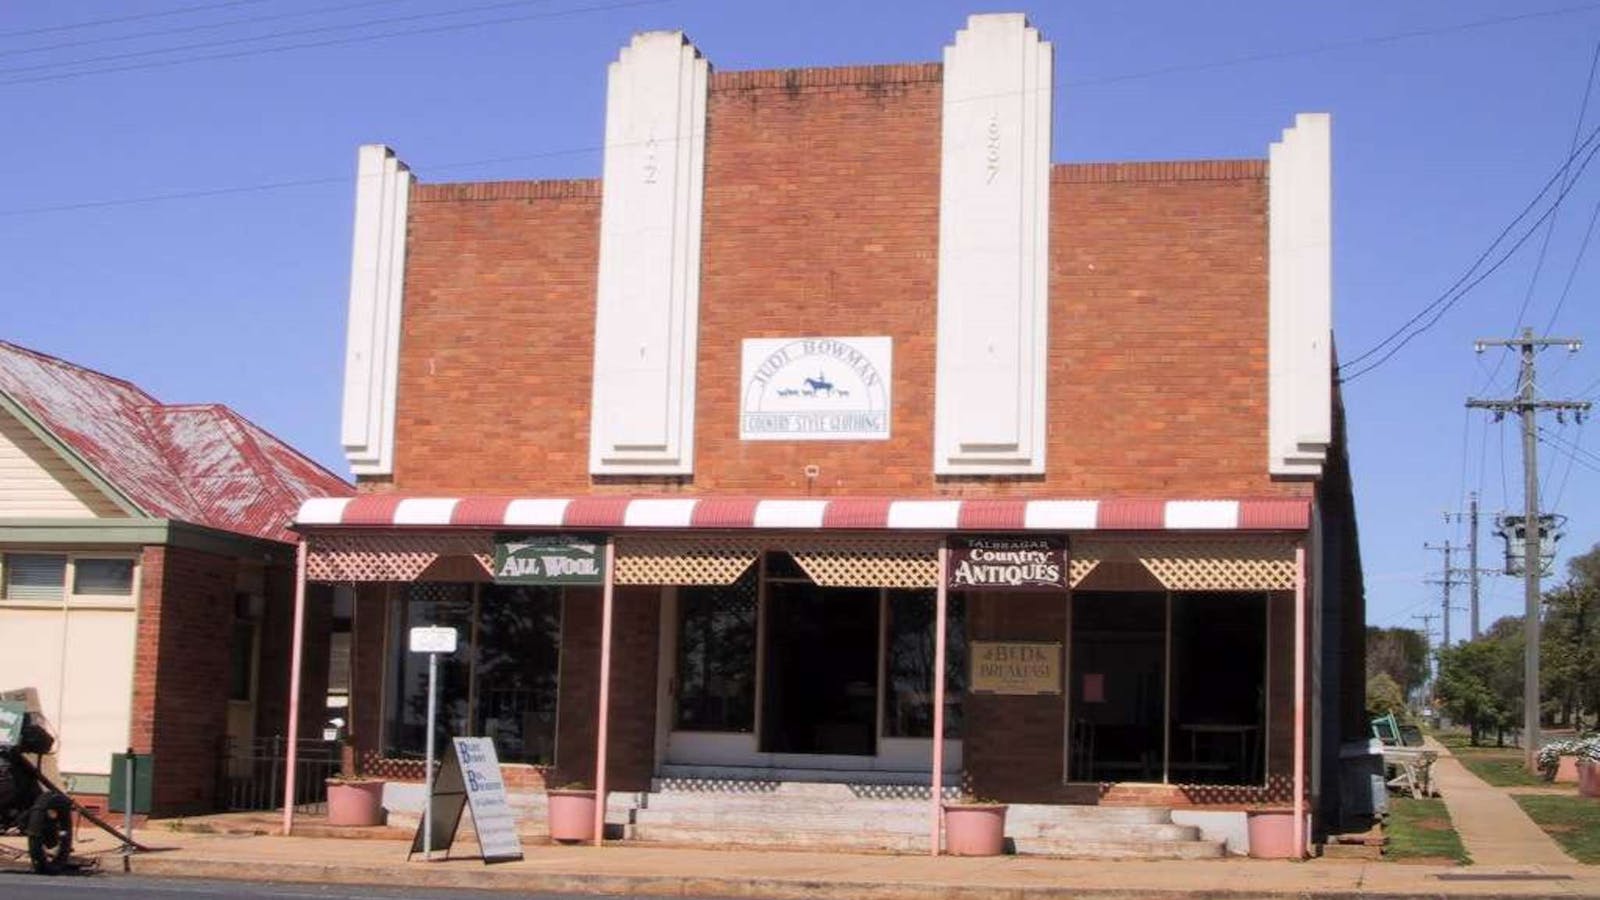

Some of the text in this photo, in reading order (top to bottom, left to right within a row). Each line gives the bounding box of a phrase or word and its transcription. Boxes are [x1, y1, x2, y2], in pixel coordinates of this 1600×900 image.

[801, 340, 880, 387] BOWMAN
[795, 413, 829, 431] STYLE
[498, 556, 600, 577] ALL WOOL
[970, 548, 1054, 564] Country
[955, 560, 1060, 585] ANTIQUES
